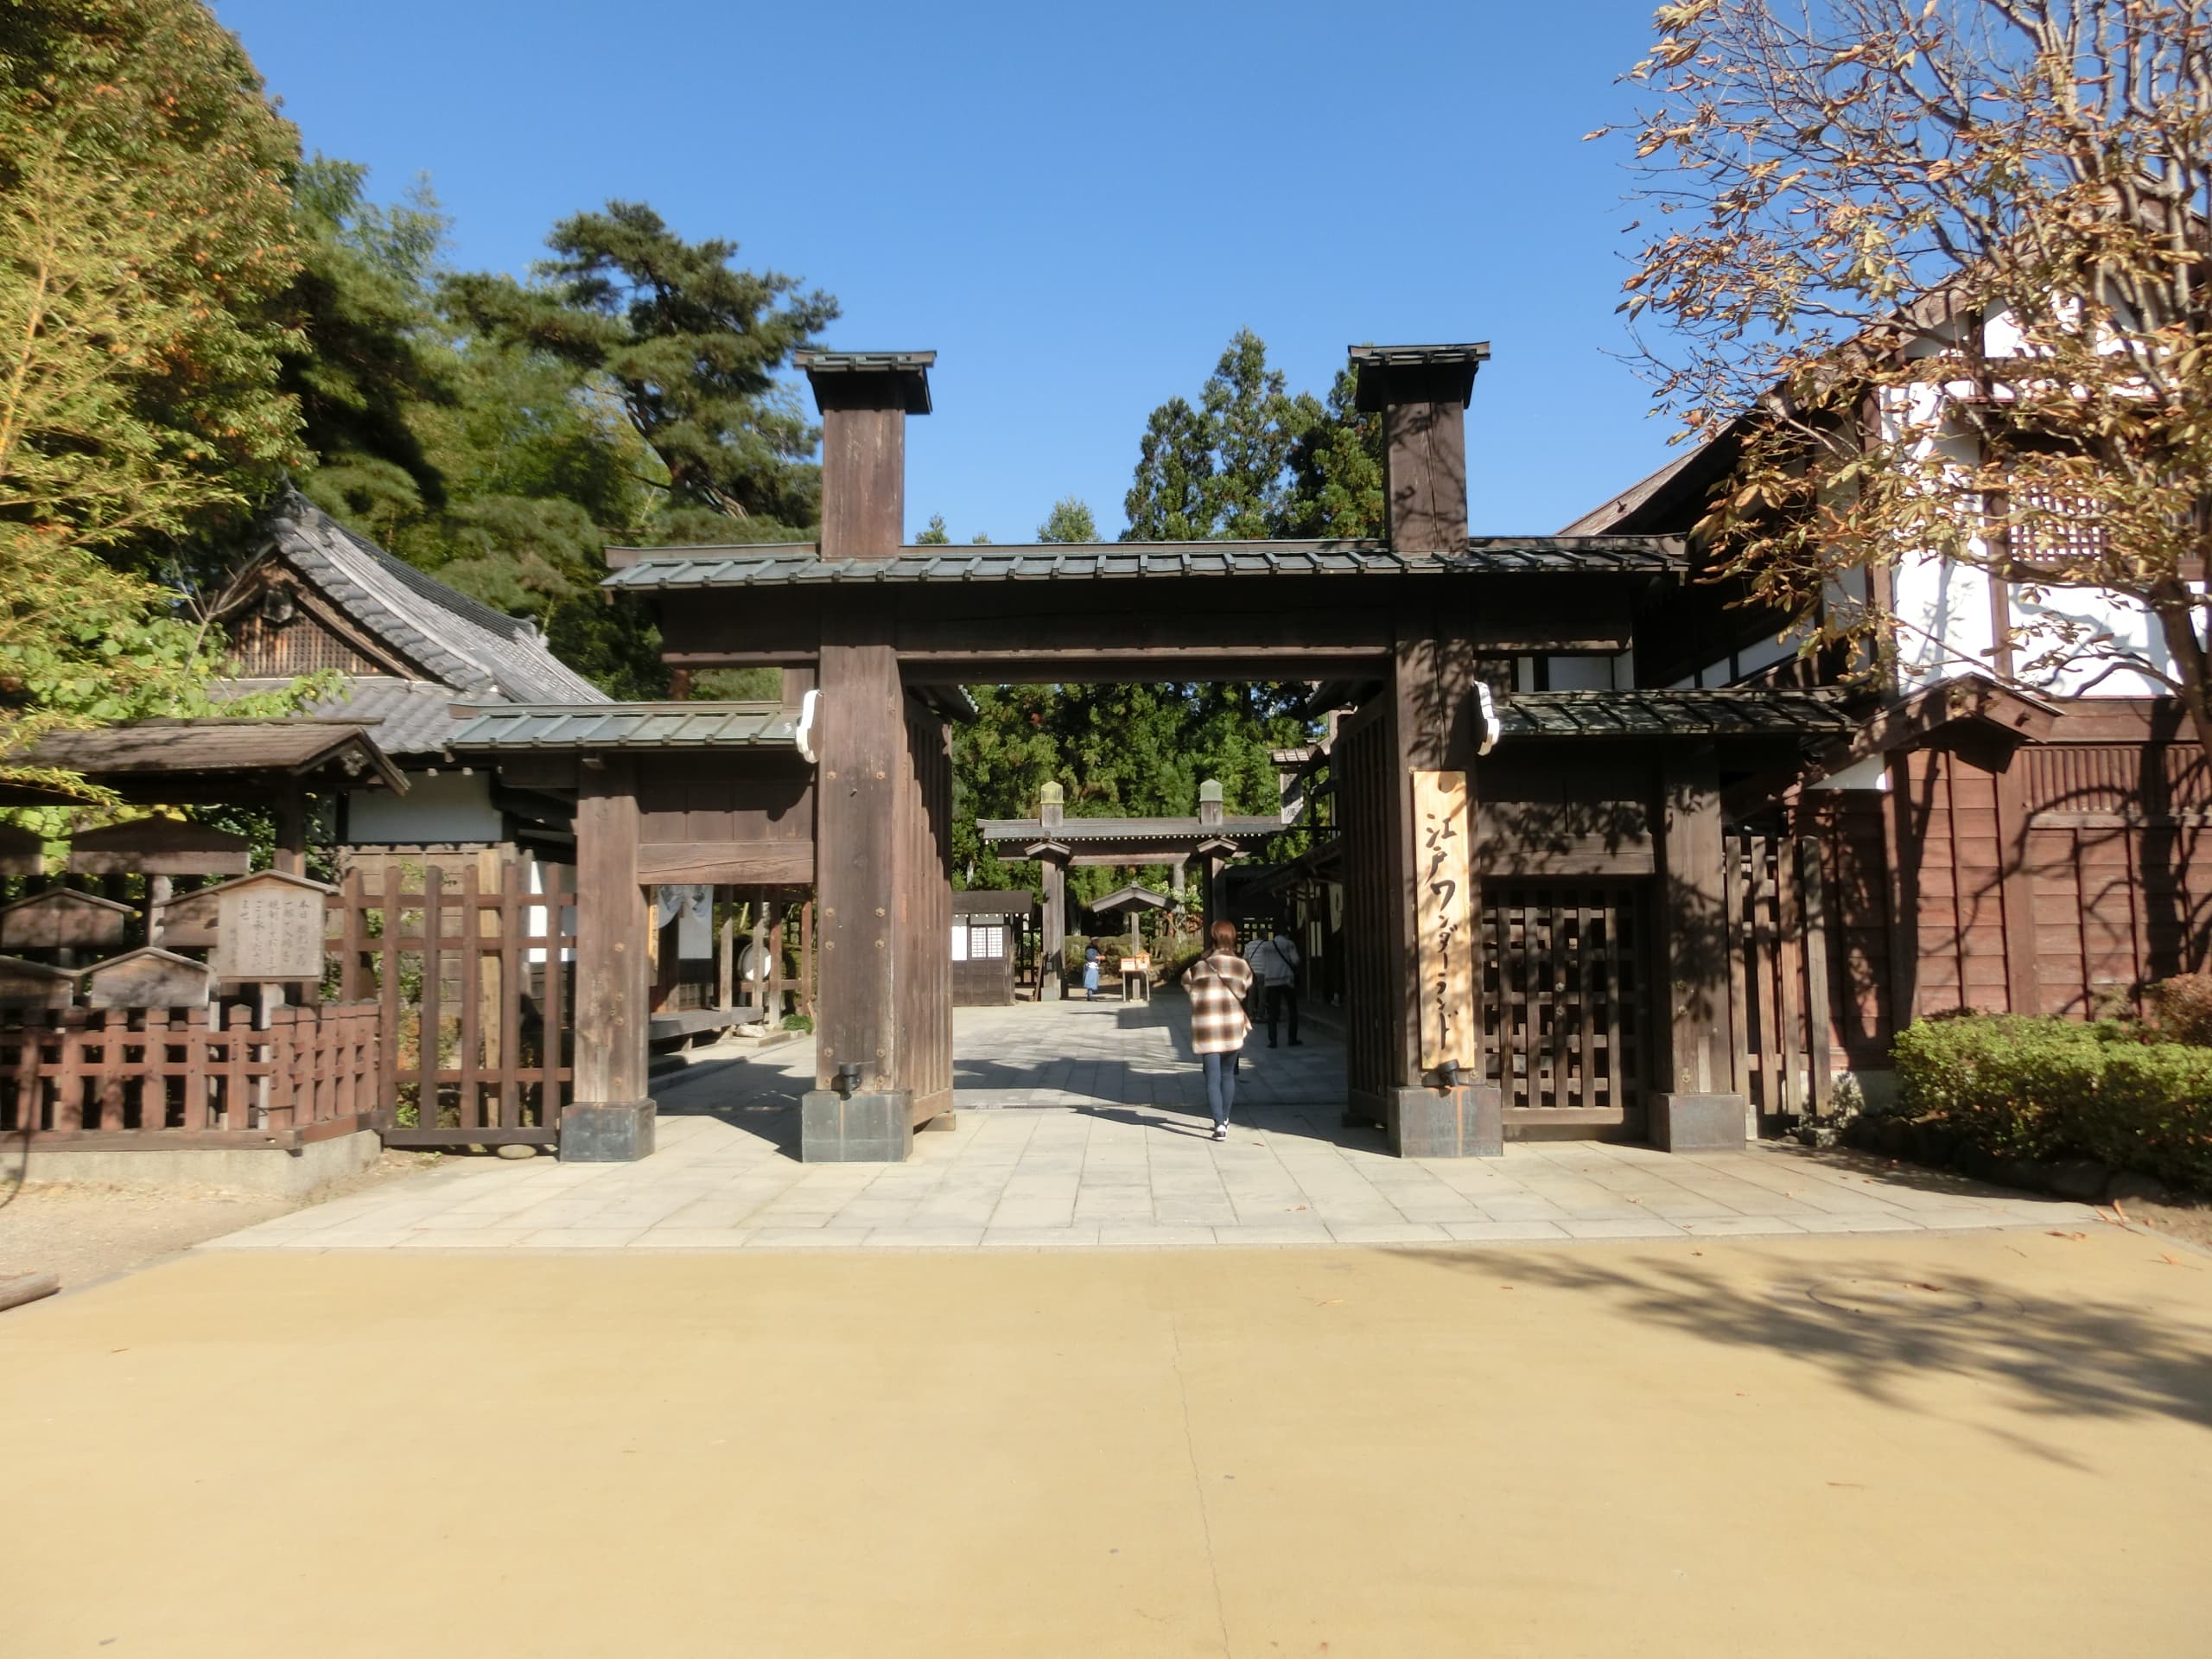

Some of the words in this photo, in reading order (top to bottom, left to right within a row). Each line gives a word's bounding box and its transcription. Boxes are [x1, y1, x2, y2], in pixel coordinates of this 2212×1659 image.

[1424, 812, 1459, 1051] 江戸ワンダーランド
